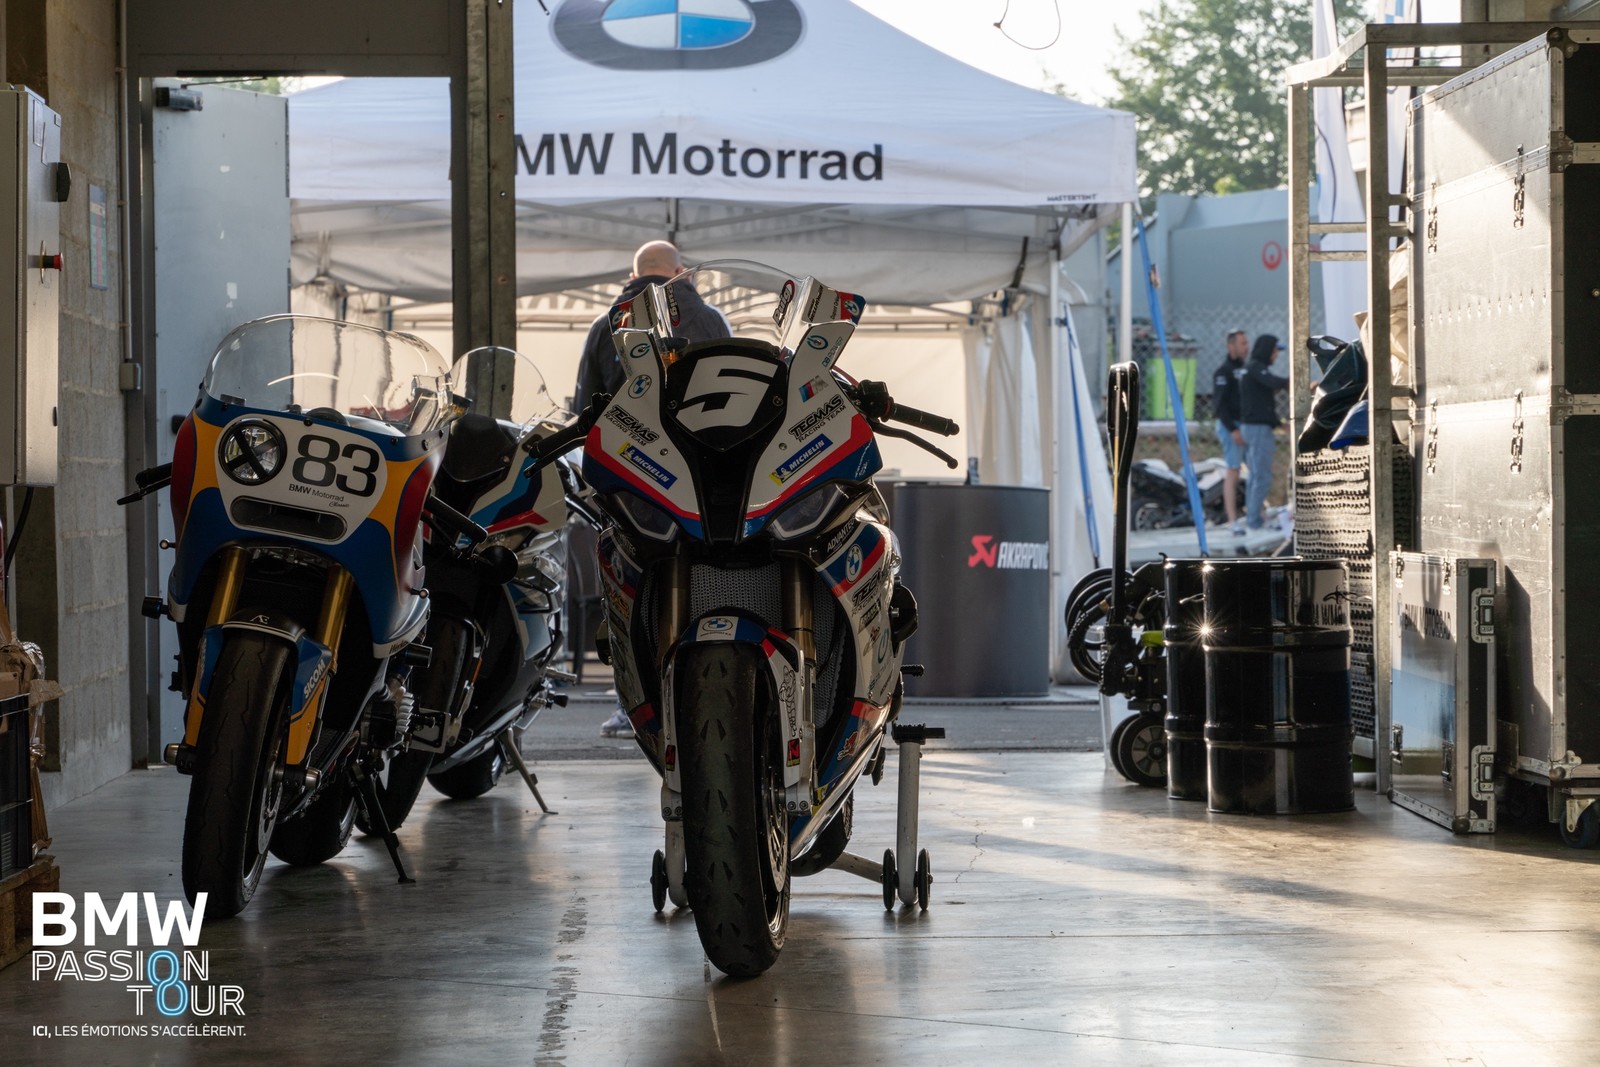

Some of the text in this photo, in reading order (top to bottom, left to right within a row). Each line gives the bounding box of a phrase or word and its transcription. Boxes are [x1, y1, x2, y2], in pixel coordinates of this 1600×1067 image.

[514, 132, 883, 181] MW Motorrad
[772, 287, 791, 327] Puig
[676, 355, 778, 433] 5
[603, 413, 648, 447] RACING TEAM
[606, 404, 660, 444] TECMAS
[788, 394, 844, 440] TECMAS
[798, 404, 847, 443] RACING TEAM
[292, 434, 380, 498] 83
[632, 456, 670, 482] MICHELIN
[788, 439, 825, 470] MICHELIN
[288, 483, 345, 502] BMW Motorrad
[303, 659, 326, 699] SICOM
